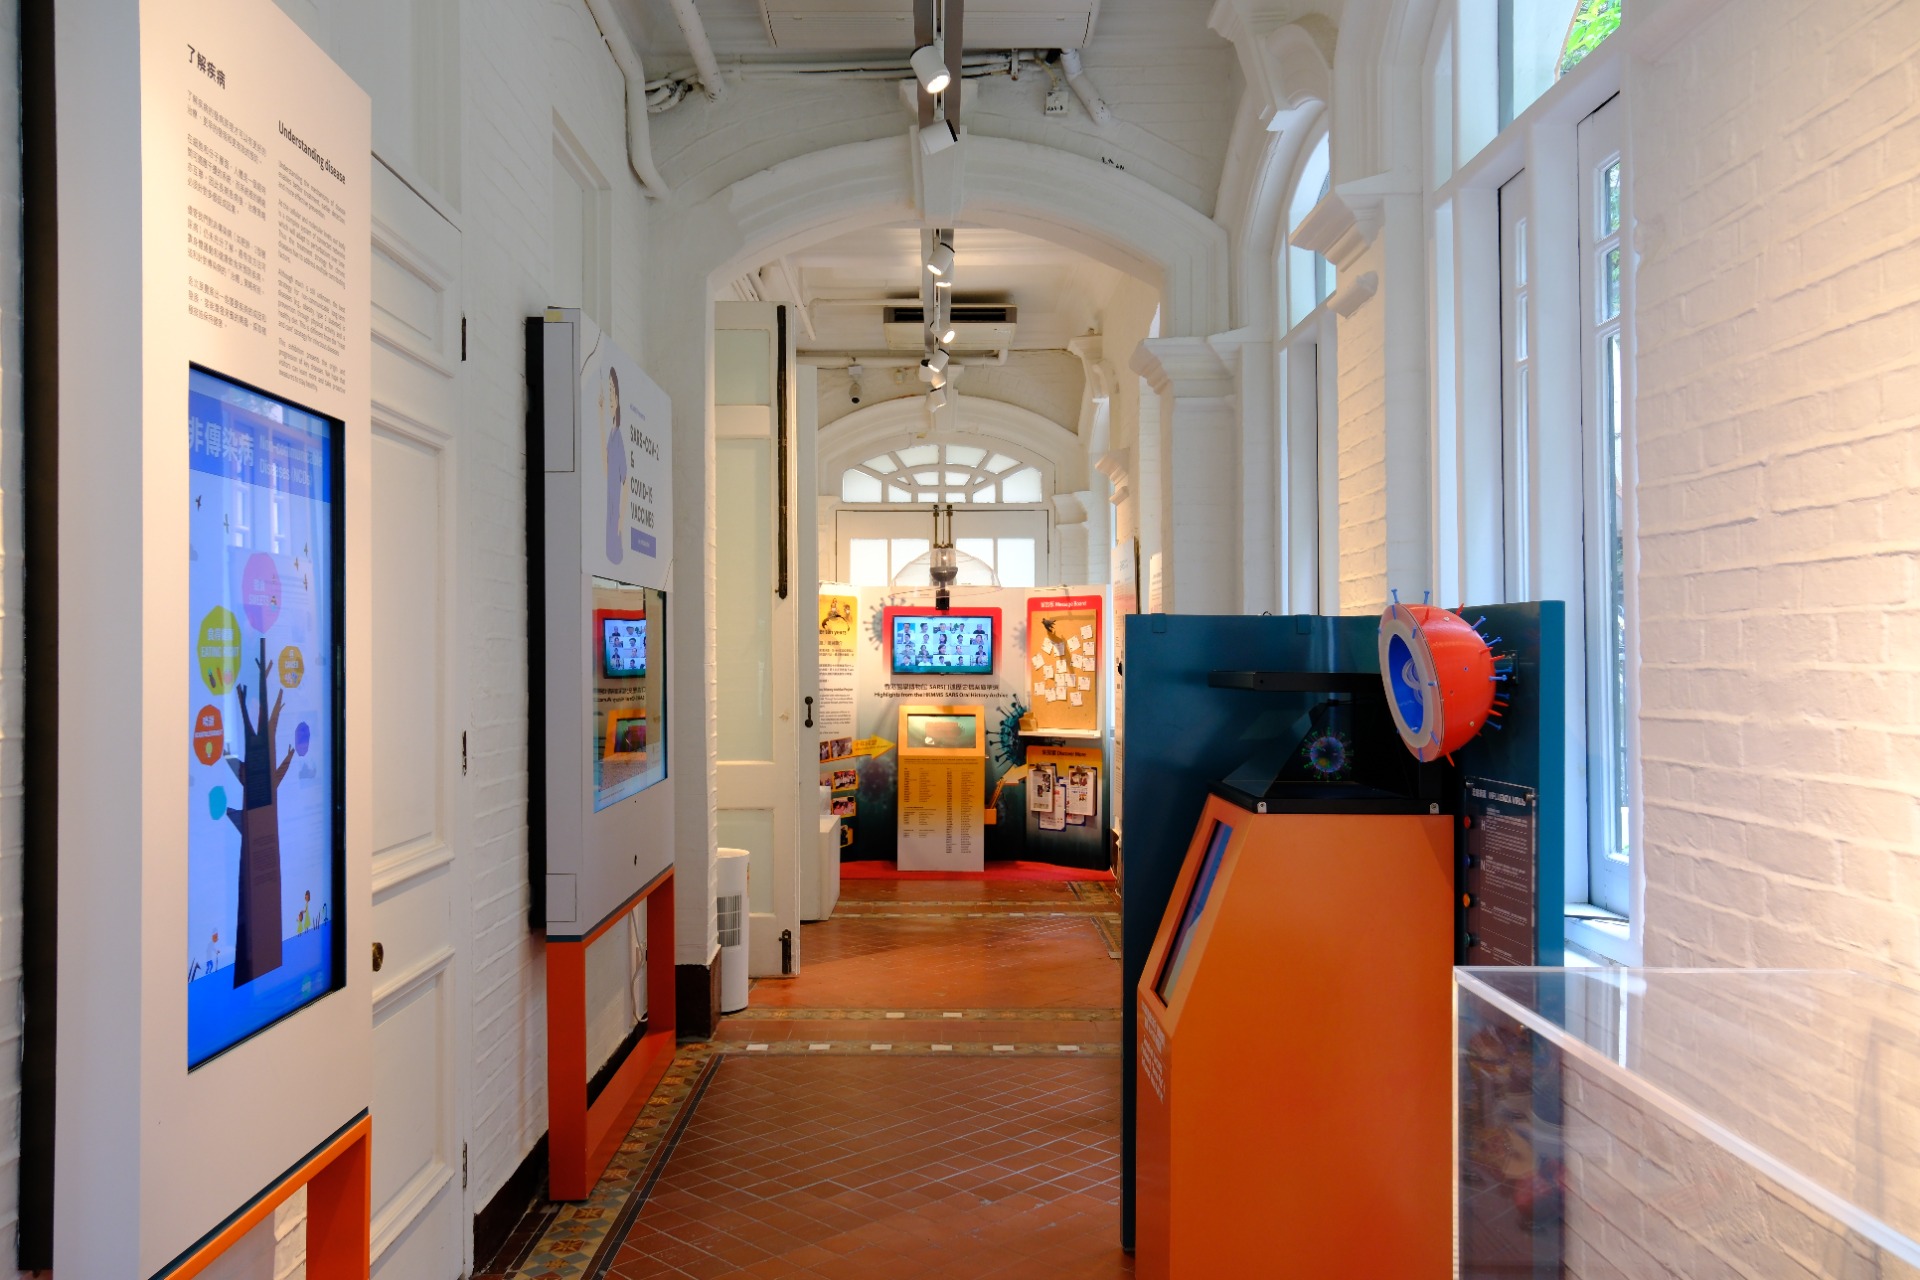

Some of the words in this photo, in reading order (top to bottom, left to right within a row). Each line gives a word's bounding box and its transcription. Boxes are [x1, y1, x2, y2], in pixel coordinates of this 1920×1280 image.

[187, 43, 226, 90] 了解疾病
[279, 119, 324, 171] Understanding
[325, 158, 346, 185] disease
[189, 416, 254, 466] 非傳染病
[630, 501, 655, 529] VACCINES
